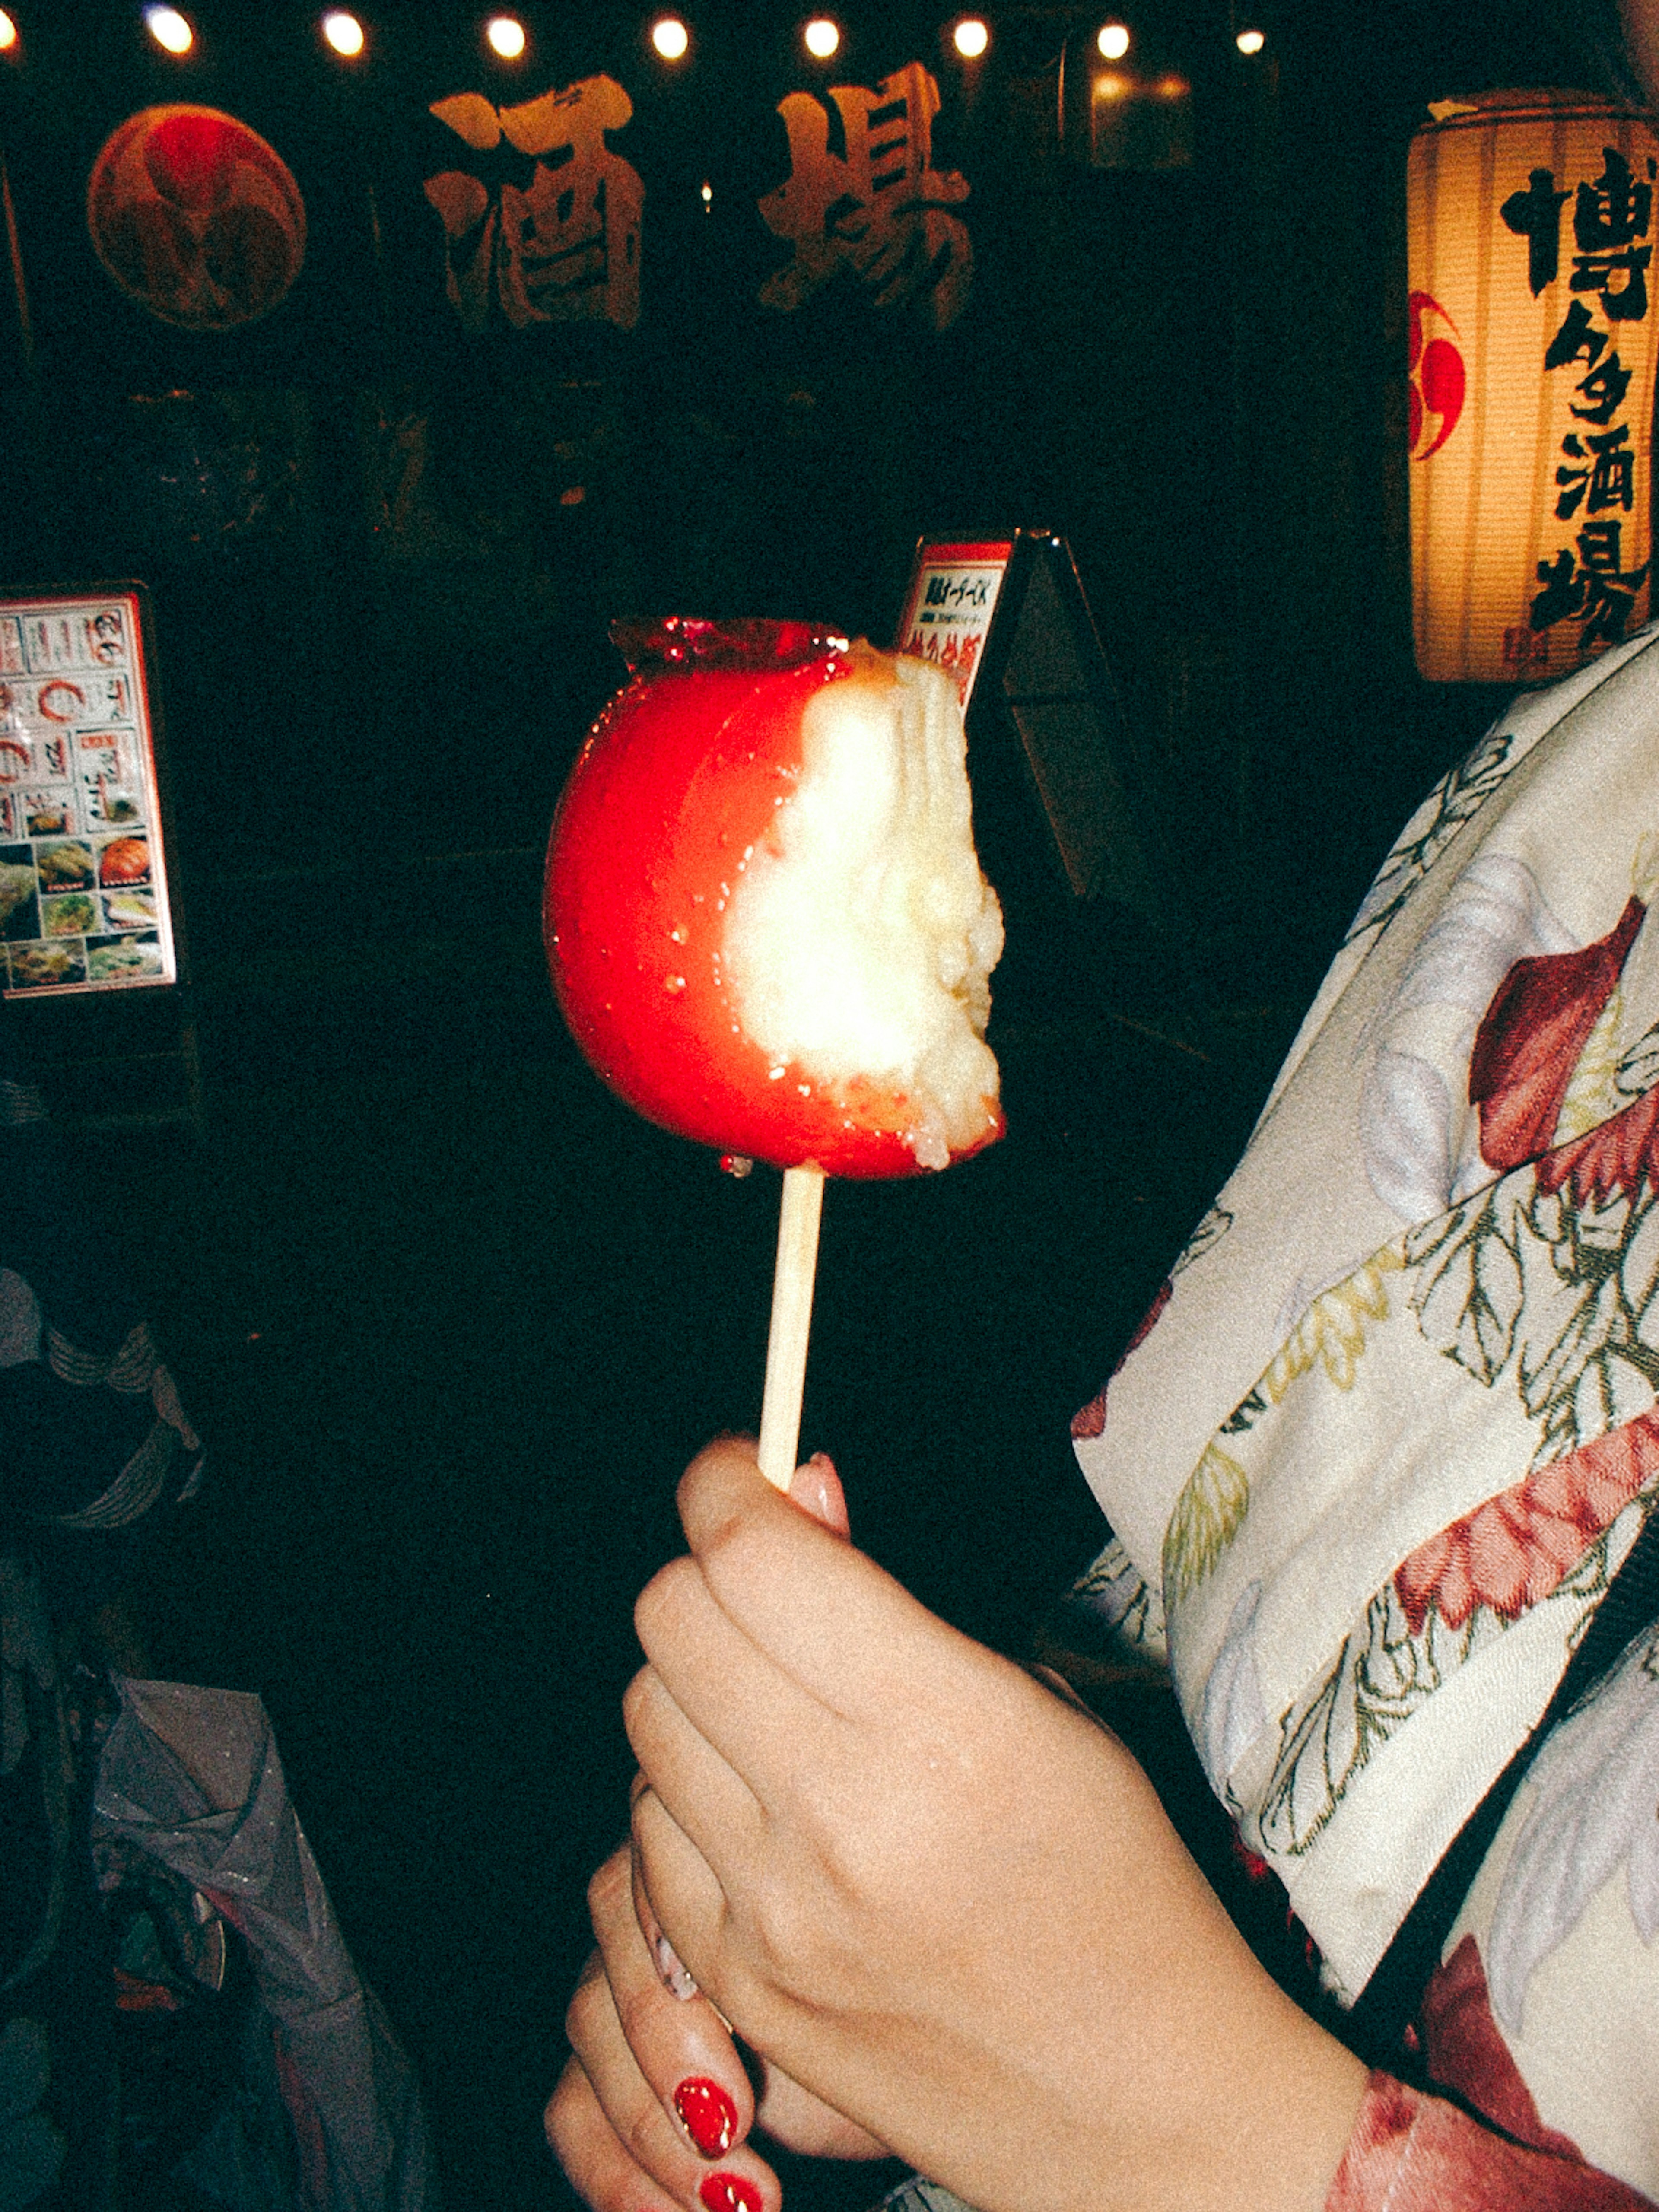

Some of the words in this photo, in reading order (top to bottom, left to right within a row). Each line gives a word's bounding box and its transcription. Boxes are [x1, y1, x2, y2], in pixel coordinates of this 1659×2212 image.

[423, 60, 974, 331] 酒場
[1500, 147, 1657, 649] 博多酒場
